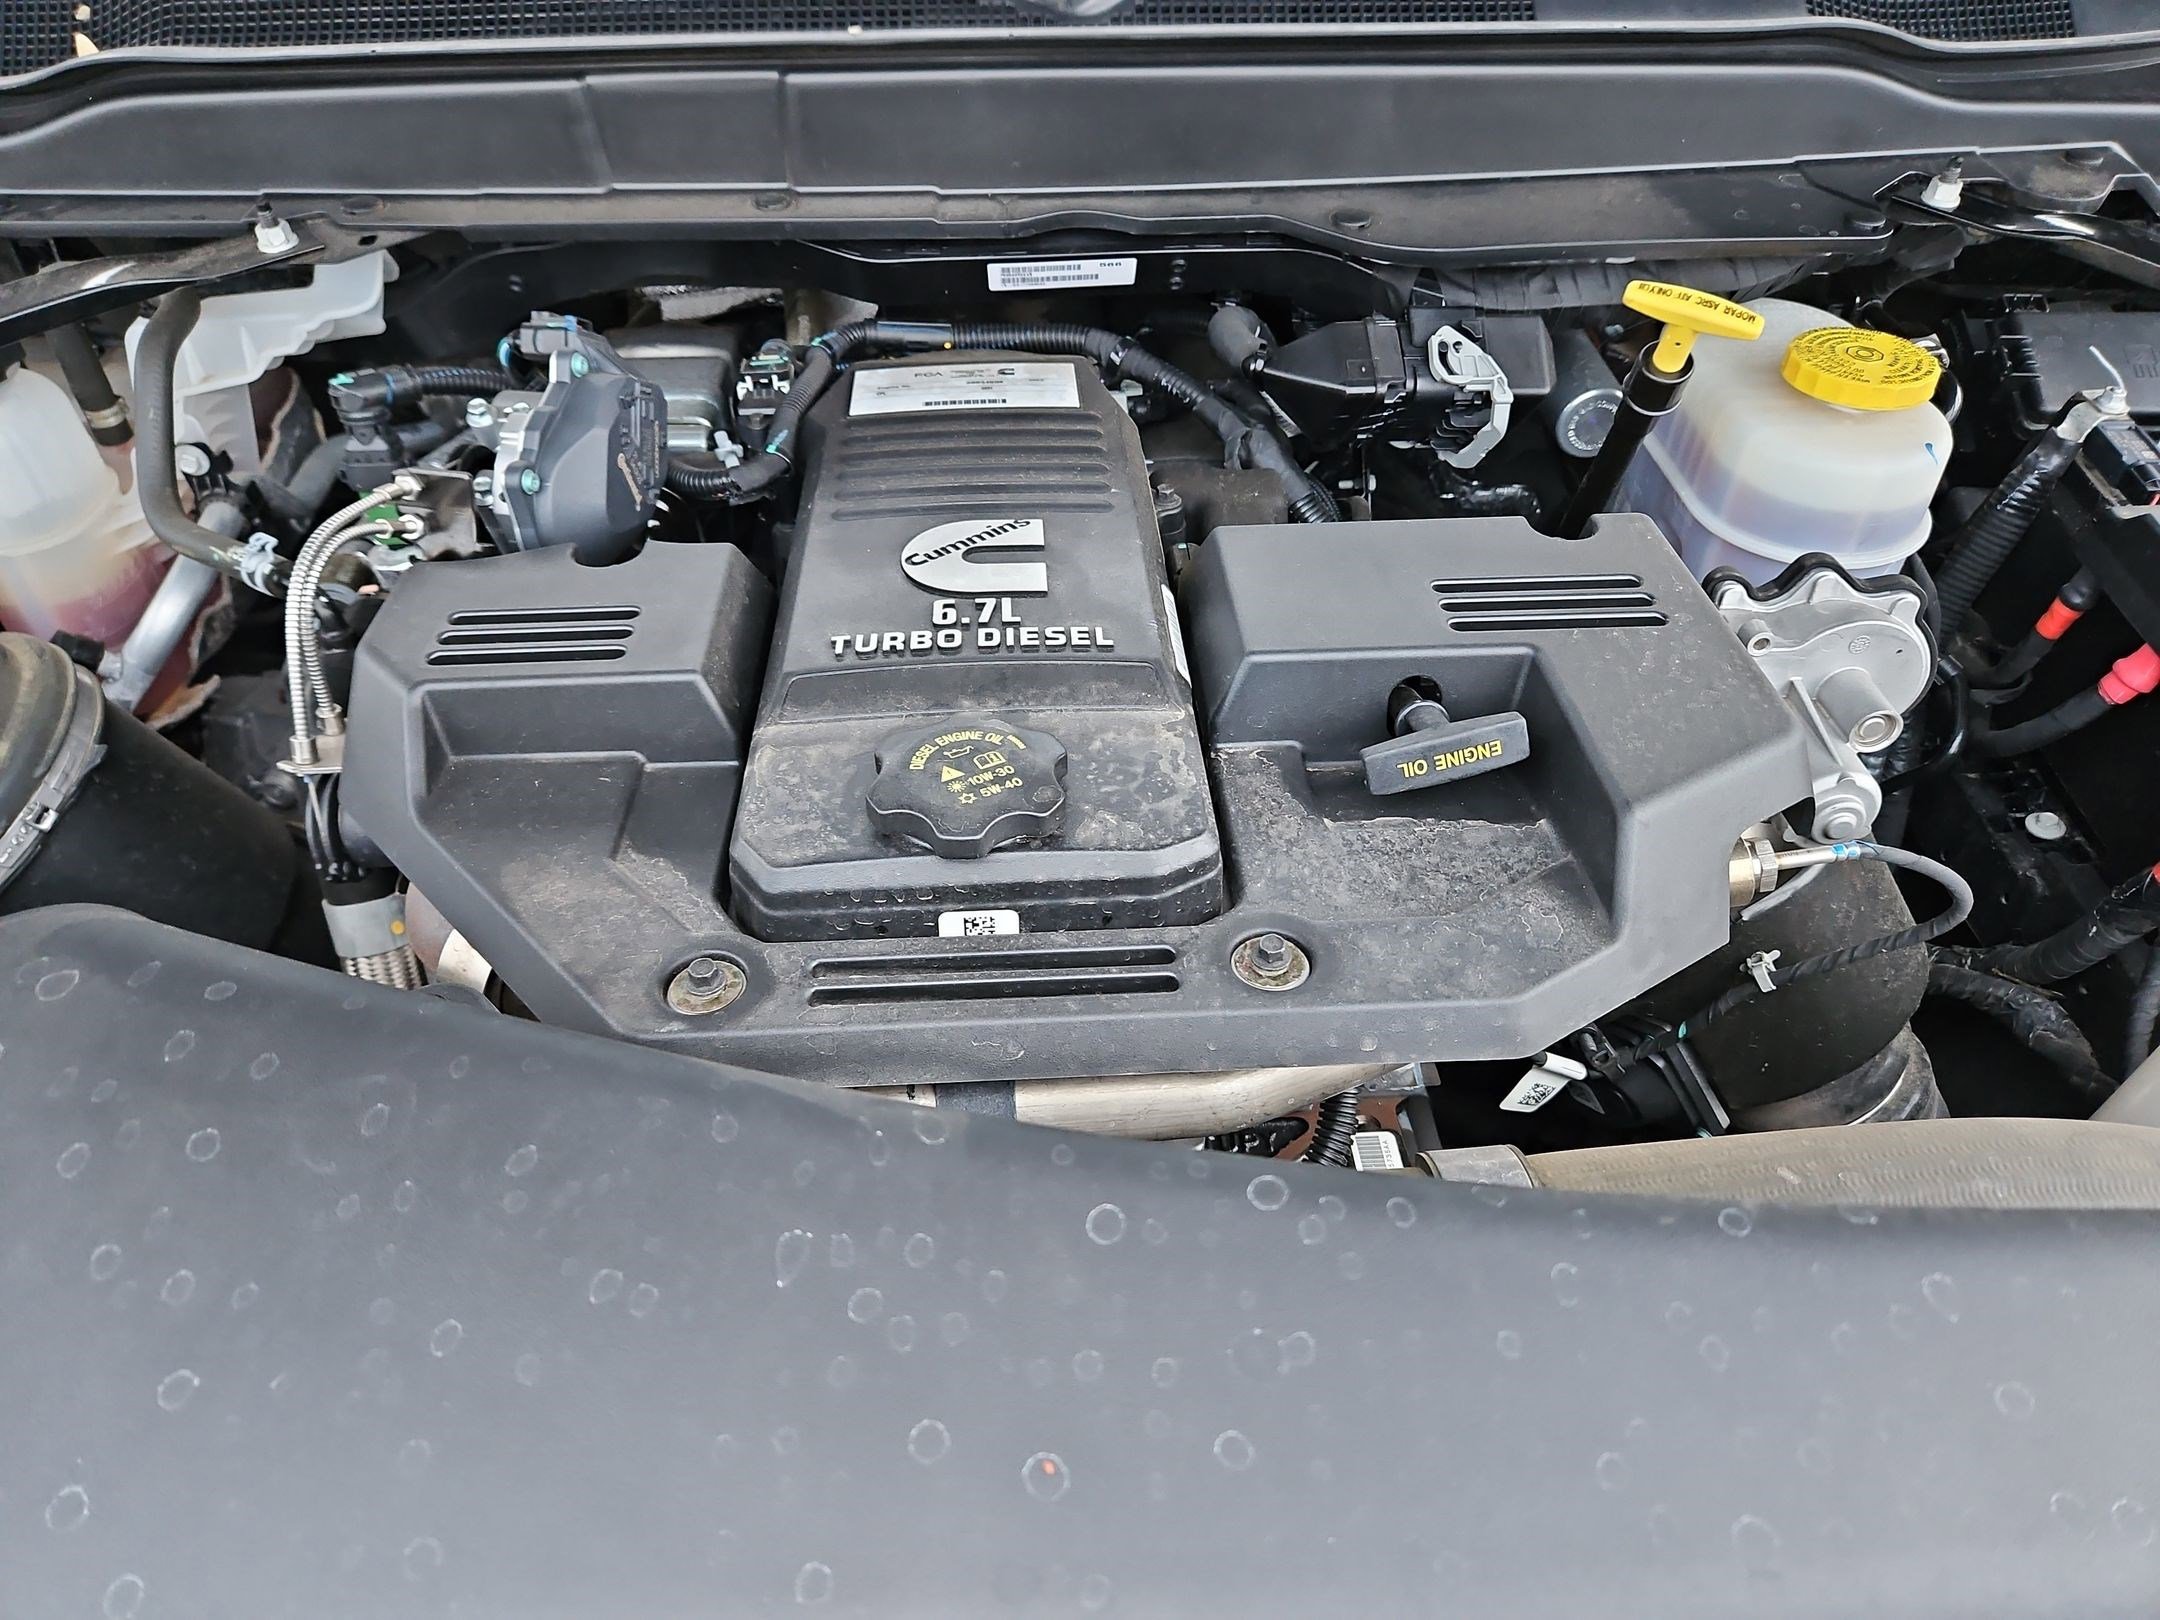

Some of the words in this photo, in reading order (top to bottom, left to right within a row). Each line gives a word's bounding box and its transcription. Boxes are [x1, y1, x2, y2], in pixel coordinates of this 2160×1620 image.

[1722, 305, 1757, 323] MOPAR
[904, 518, 1031, 566] Cummins
[932, 597, 1022, 626] 6.7L
[830, 629, 963, 655] TURBO
[977, 626, 1115, 649] DIESEL
[909, 743, 939, 770] DIESEL
[935, 731, 984, 746] ENGINE
[984, 731, 1004, 746] OIL
[1433, 740, 1502, 771] ENGINE
[967, 764, 1015, 786] 10W-30
[1396, 759, 1429, 778] OIL
[979, 777, 1023, 798] 5W-40
